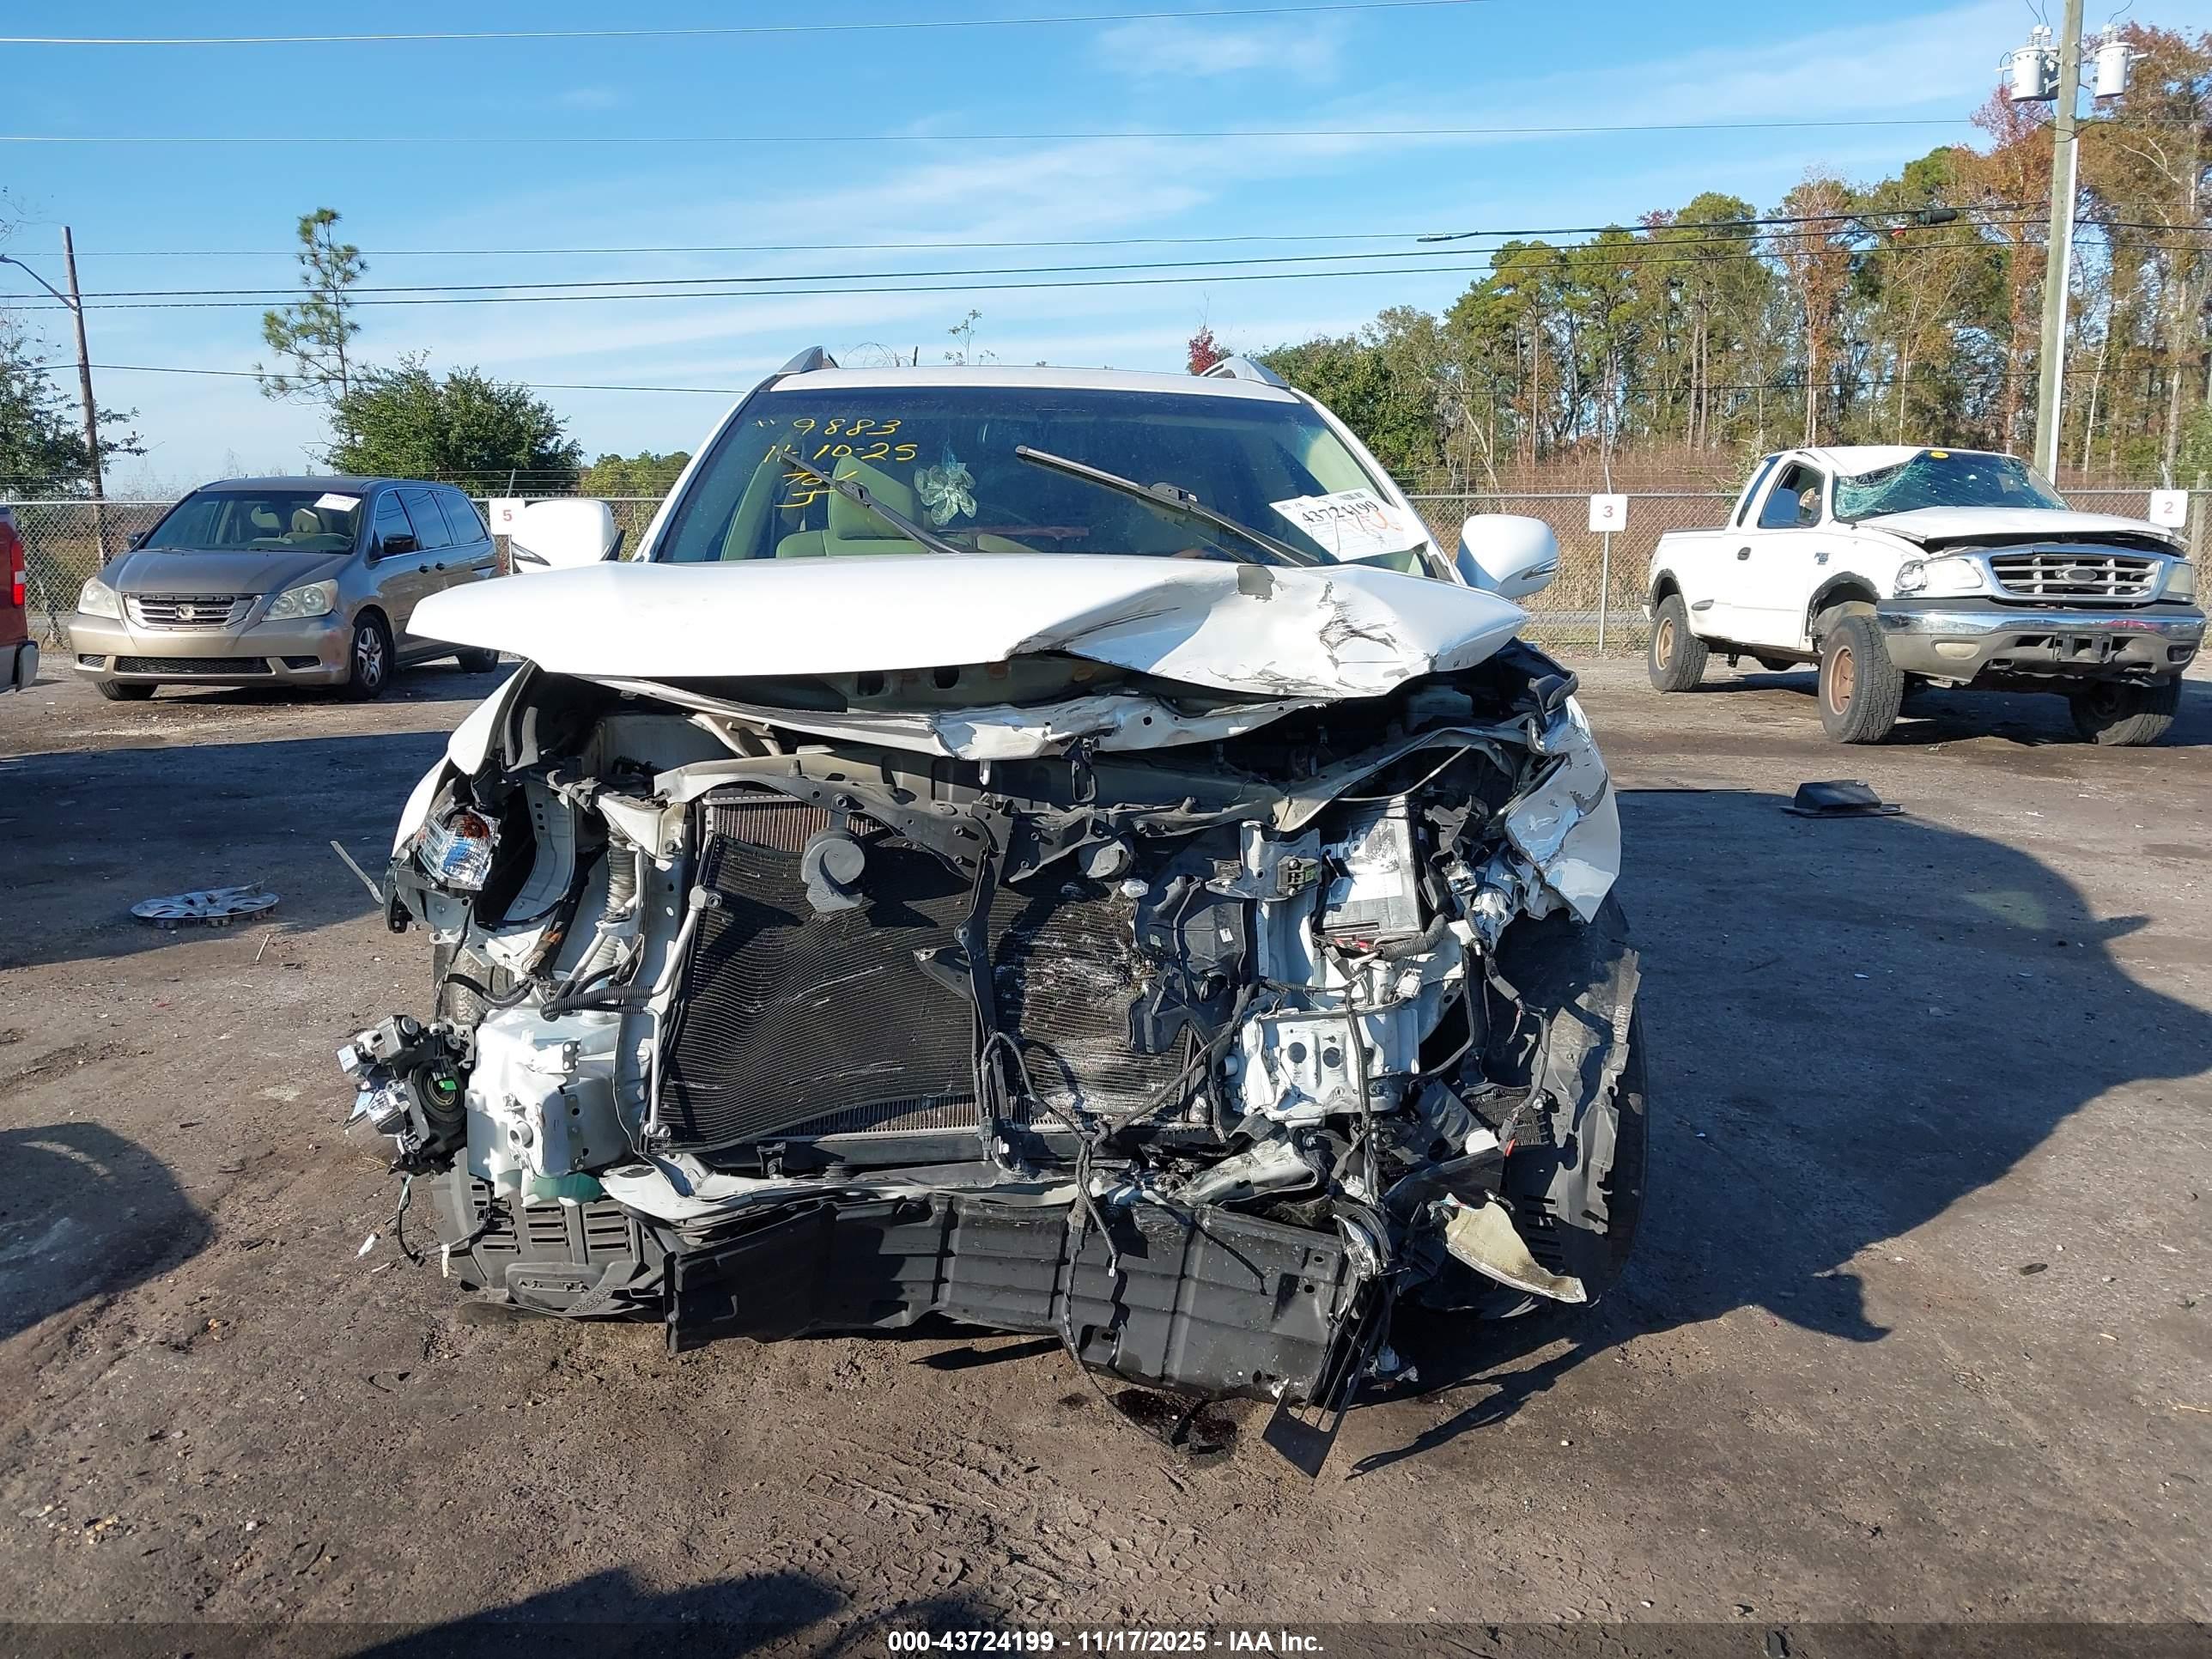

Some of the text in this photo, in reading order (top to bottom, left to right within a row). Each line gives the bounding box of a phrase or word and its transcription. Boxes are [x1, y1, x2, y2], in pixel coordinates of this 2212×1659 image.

[793, 417, 902, 436] 9883
[1603, 505, 1613, 518] 3
[2164, 501, 2173, 514] 2
[503, 509, 513, 522] 5
